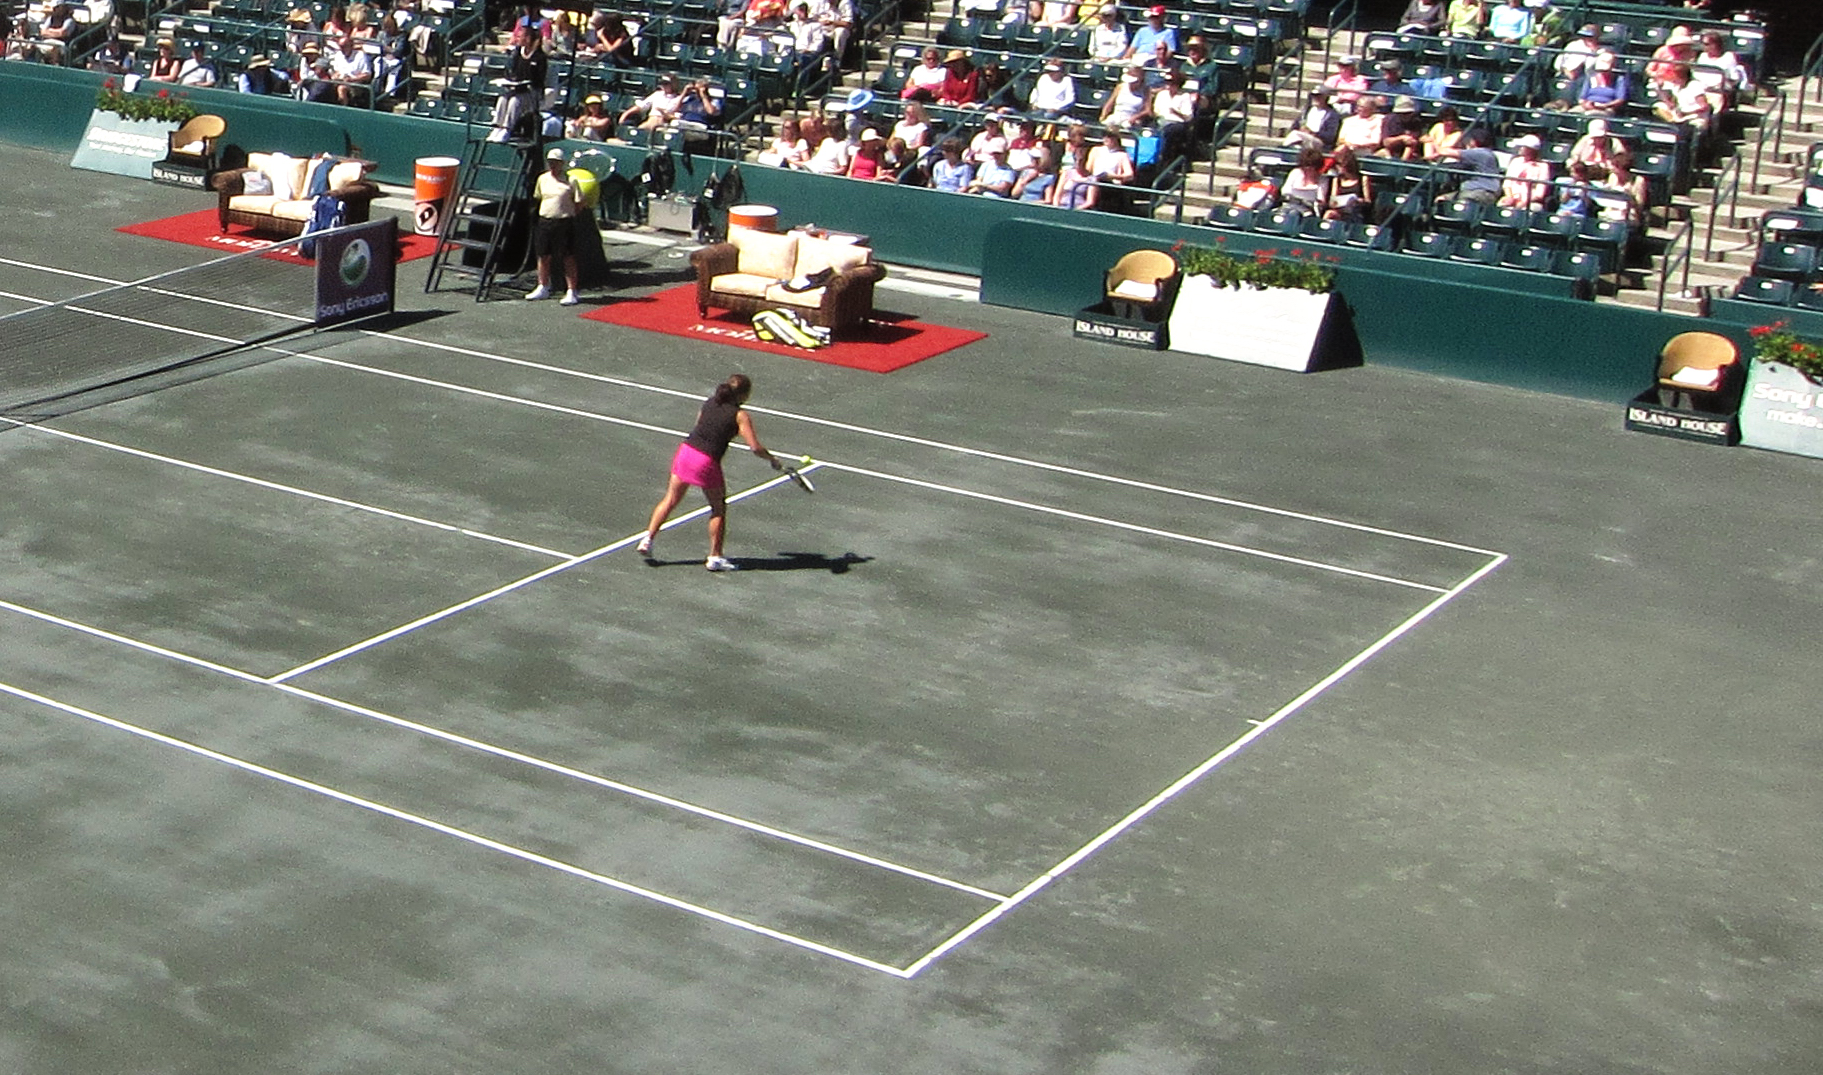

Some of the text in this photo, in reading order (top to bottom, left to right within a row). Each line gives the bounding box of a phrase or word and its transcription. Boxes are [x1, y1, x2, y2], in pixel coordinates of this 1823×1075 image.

[153, 168, 178, 181] ISLAND
[1076, 320, 1155, 343] ISLAND HOUSE
[1753, 382, 1813, 409] Sony
[1629, 408, 1727, 435] ISLAND HOUSE
